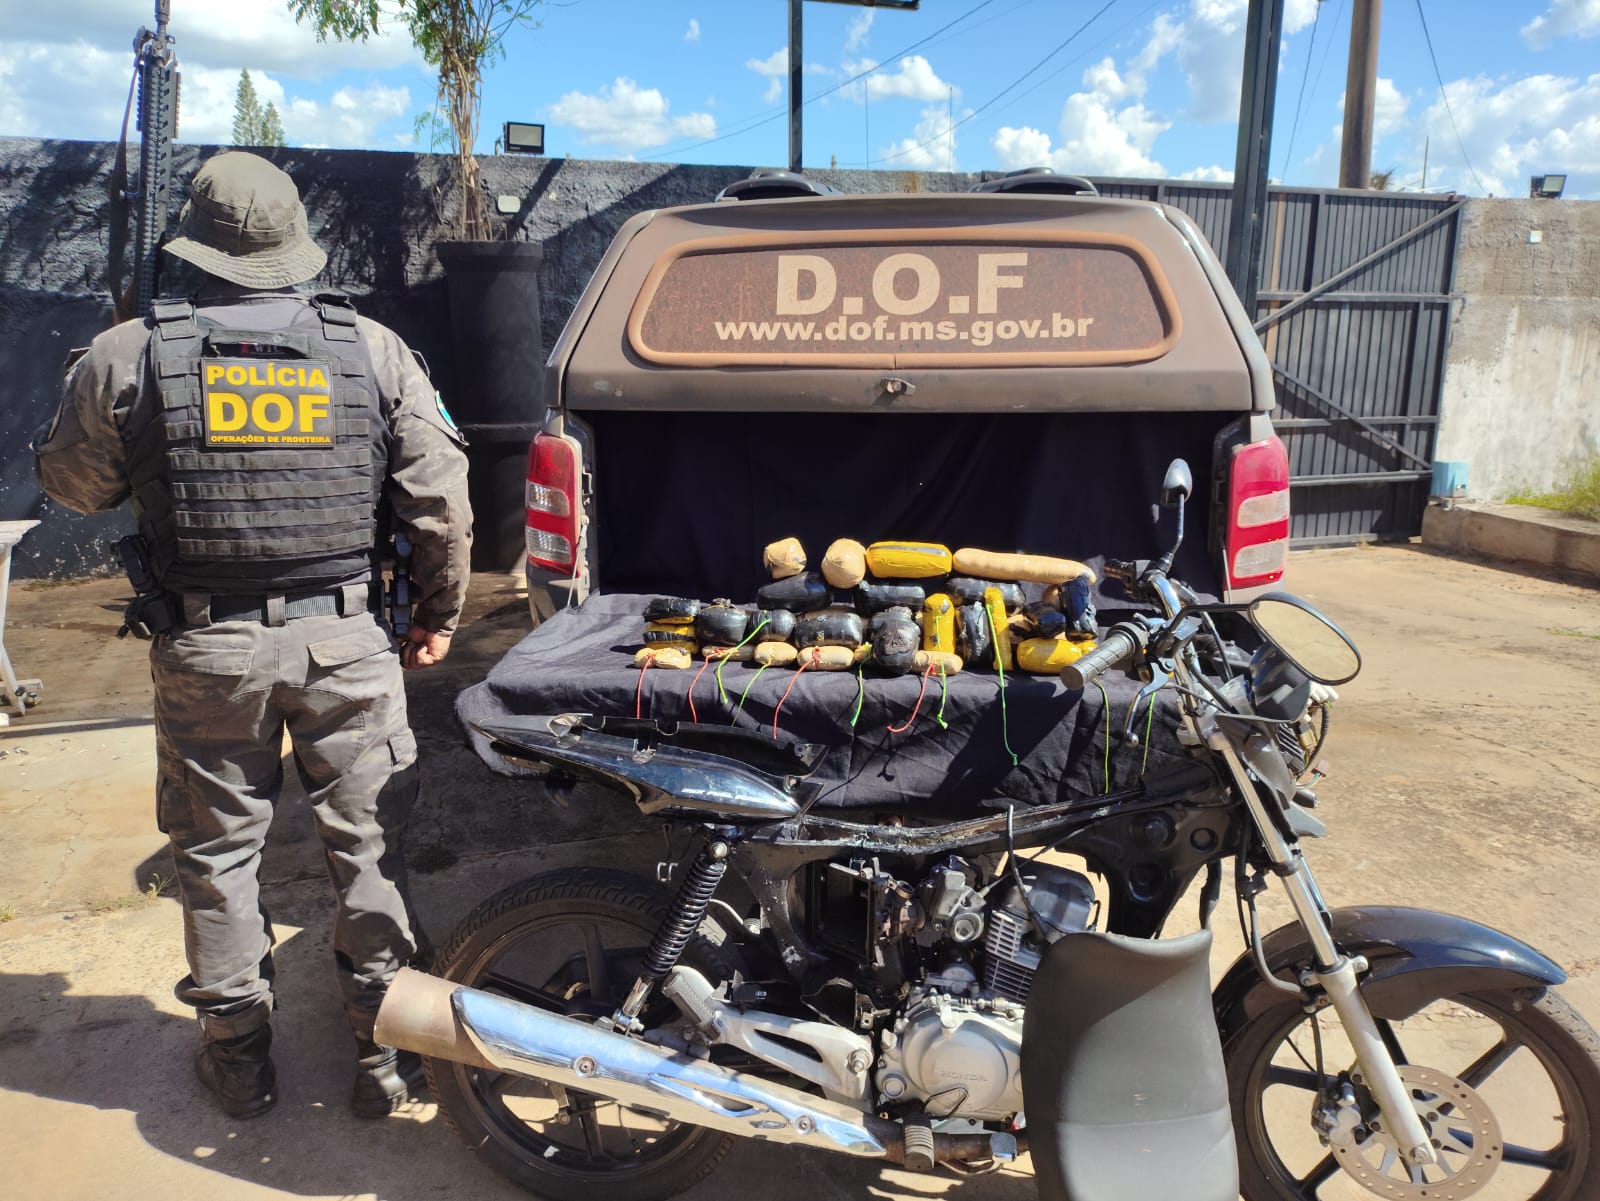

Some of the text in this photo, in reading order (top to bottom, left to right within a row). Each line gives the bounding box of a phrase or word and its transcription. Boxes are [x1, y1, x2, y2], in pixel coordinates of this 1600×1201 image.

[775, 252, 1028, 316] D.O.F
[714, 312, 1094, 347] www.dof.ms.gov.br
[206, 362, 329, 388] POLÍCIA
[207, 392, 330, 433] DOF
[210, 434, 331, 445] OPERAÇÕES DE FRONTEIRA
